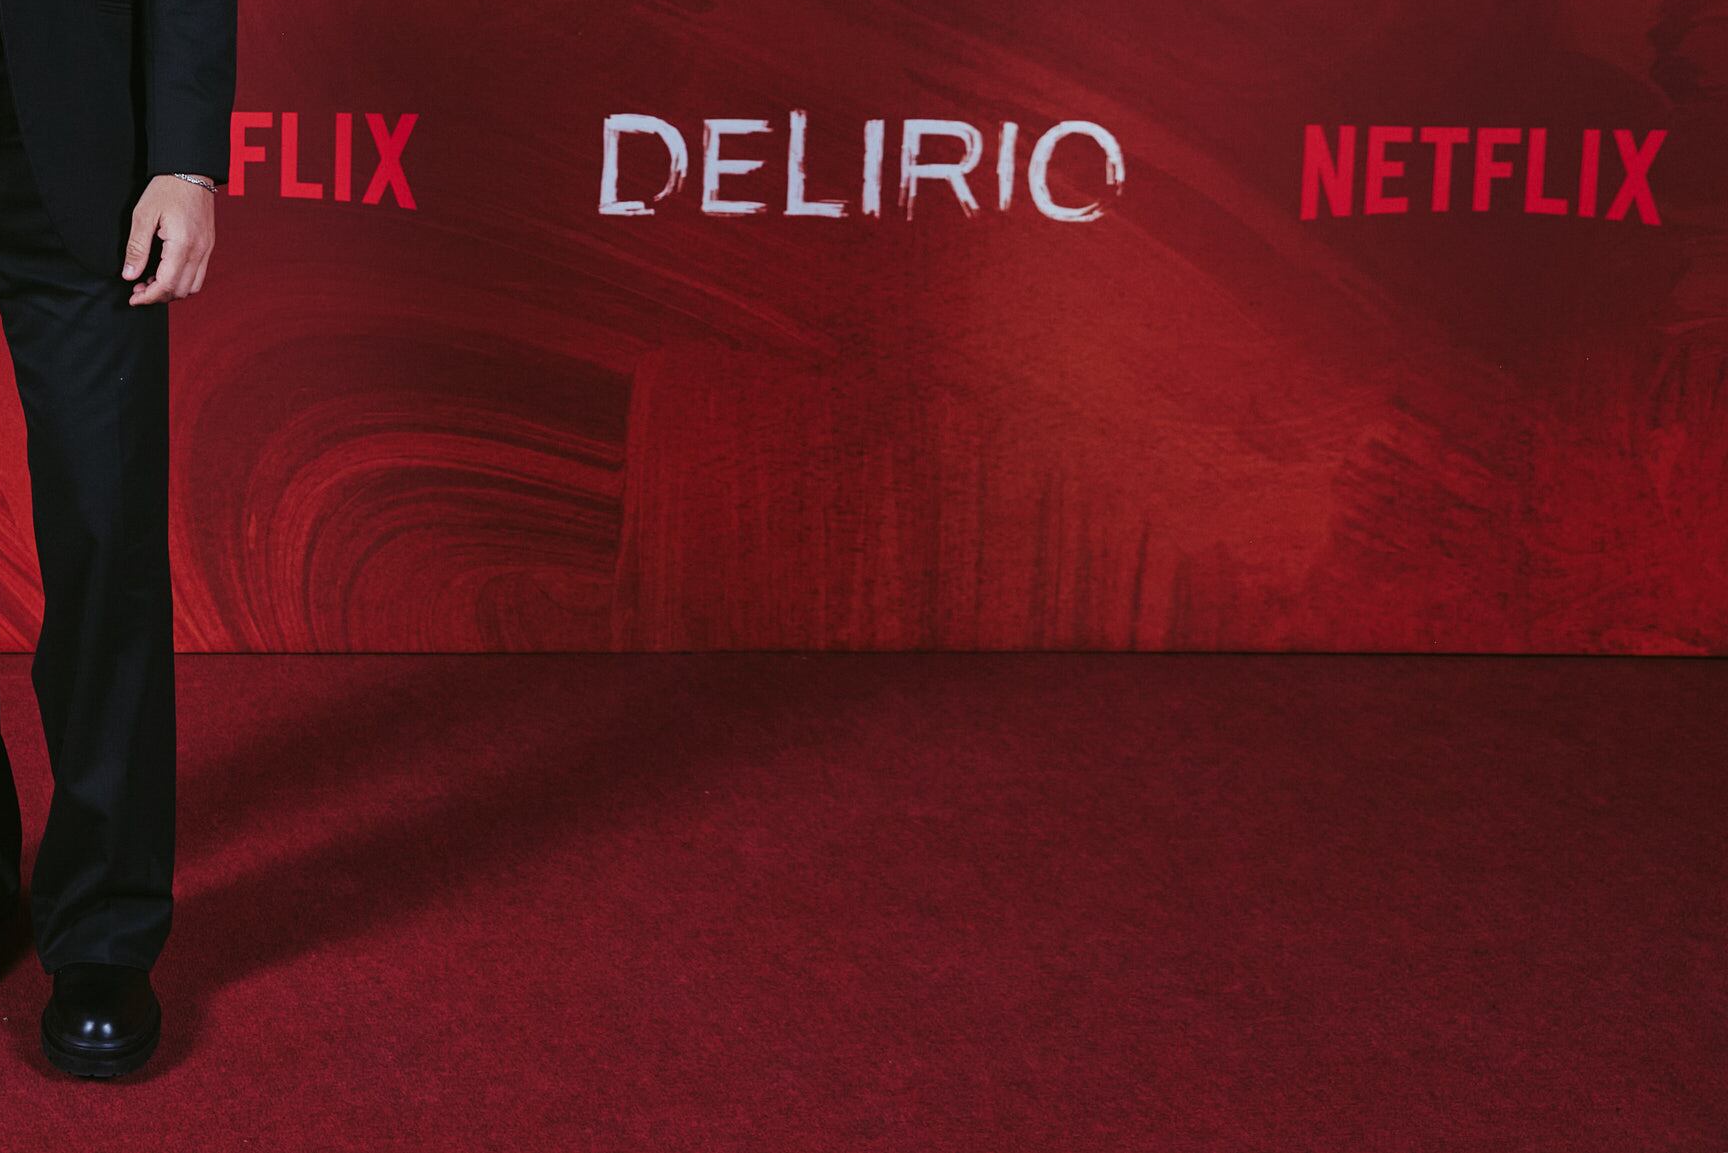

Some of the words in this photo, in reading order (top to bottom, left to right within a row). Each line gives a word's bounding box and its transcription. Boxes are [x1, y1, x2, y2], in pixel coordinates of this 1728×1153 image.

[227, 111, 419, 210] FLIX
[597, 110, 1127, 224] DELIRIO
[1300, 124, 1666, 226] NETFLIX
